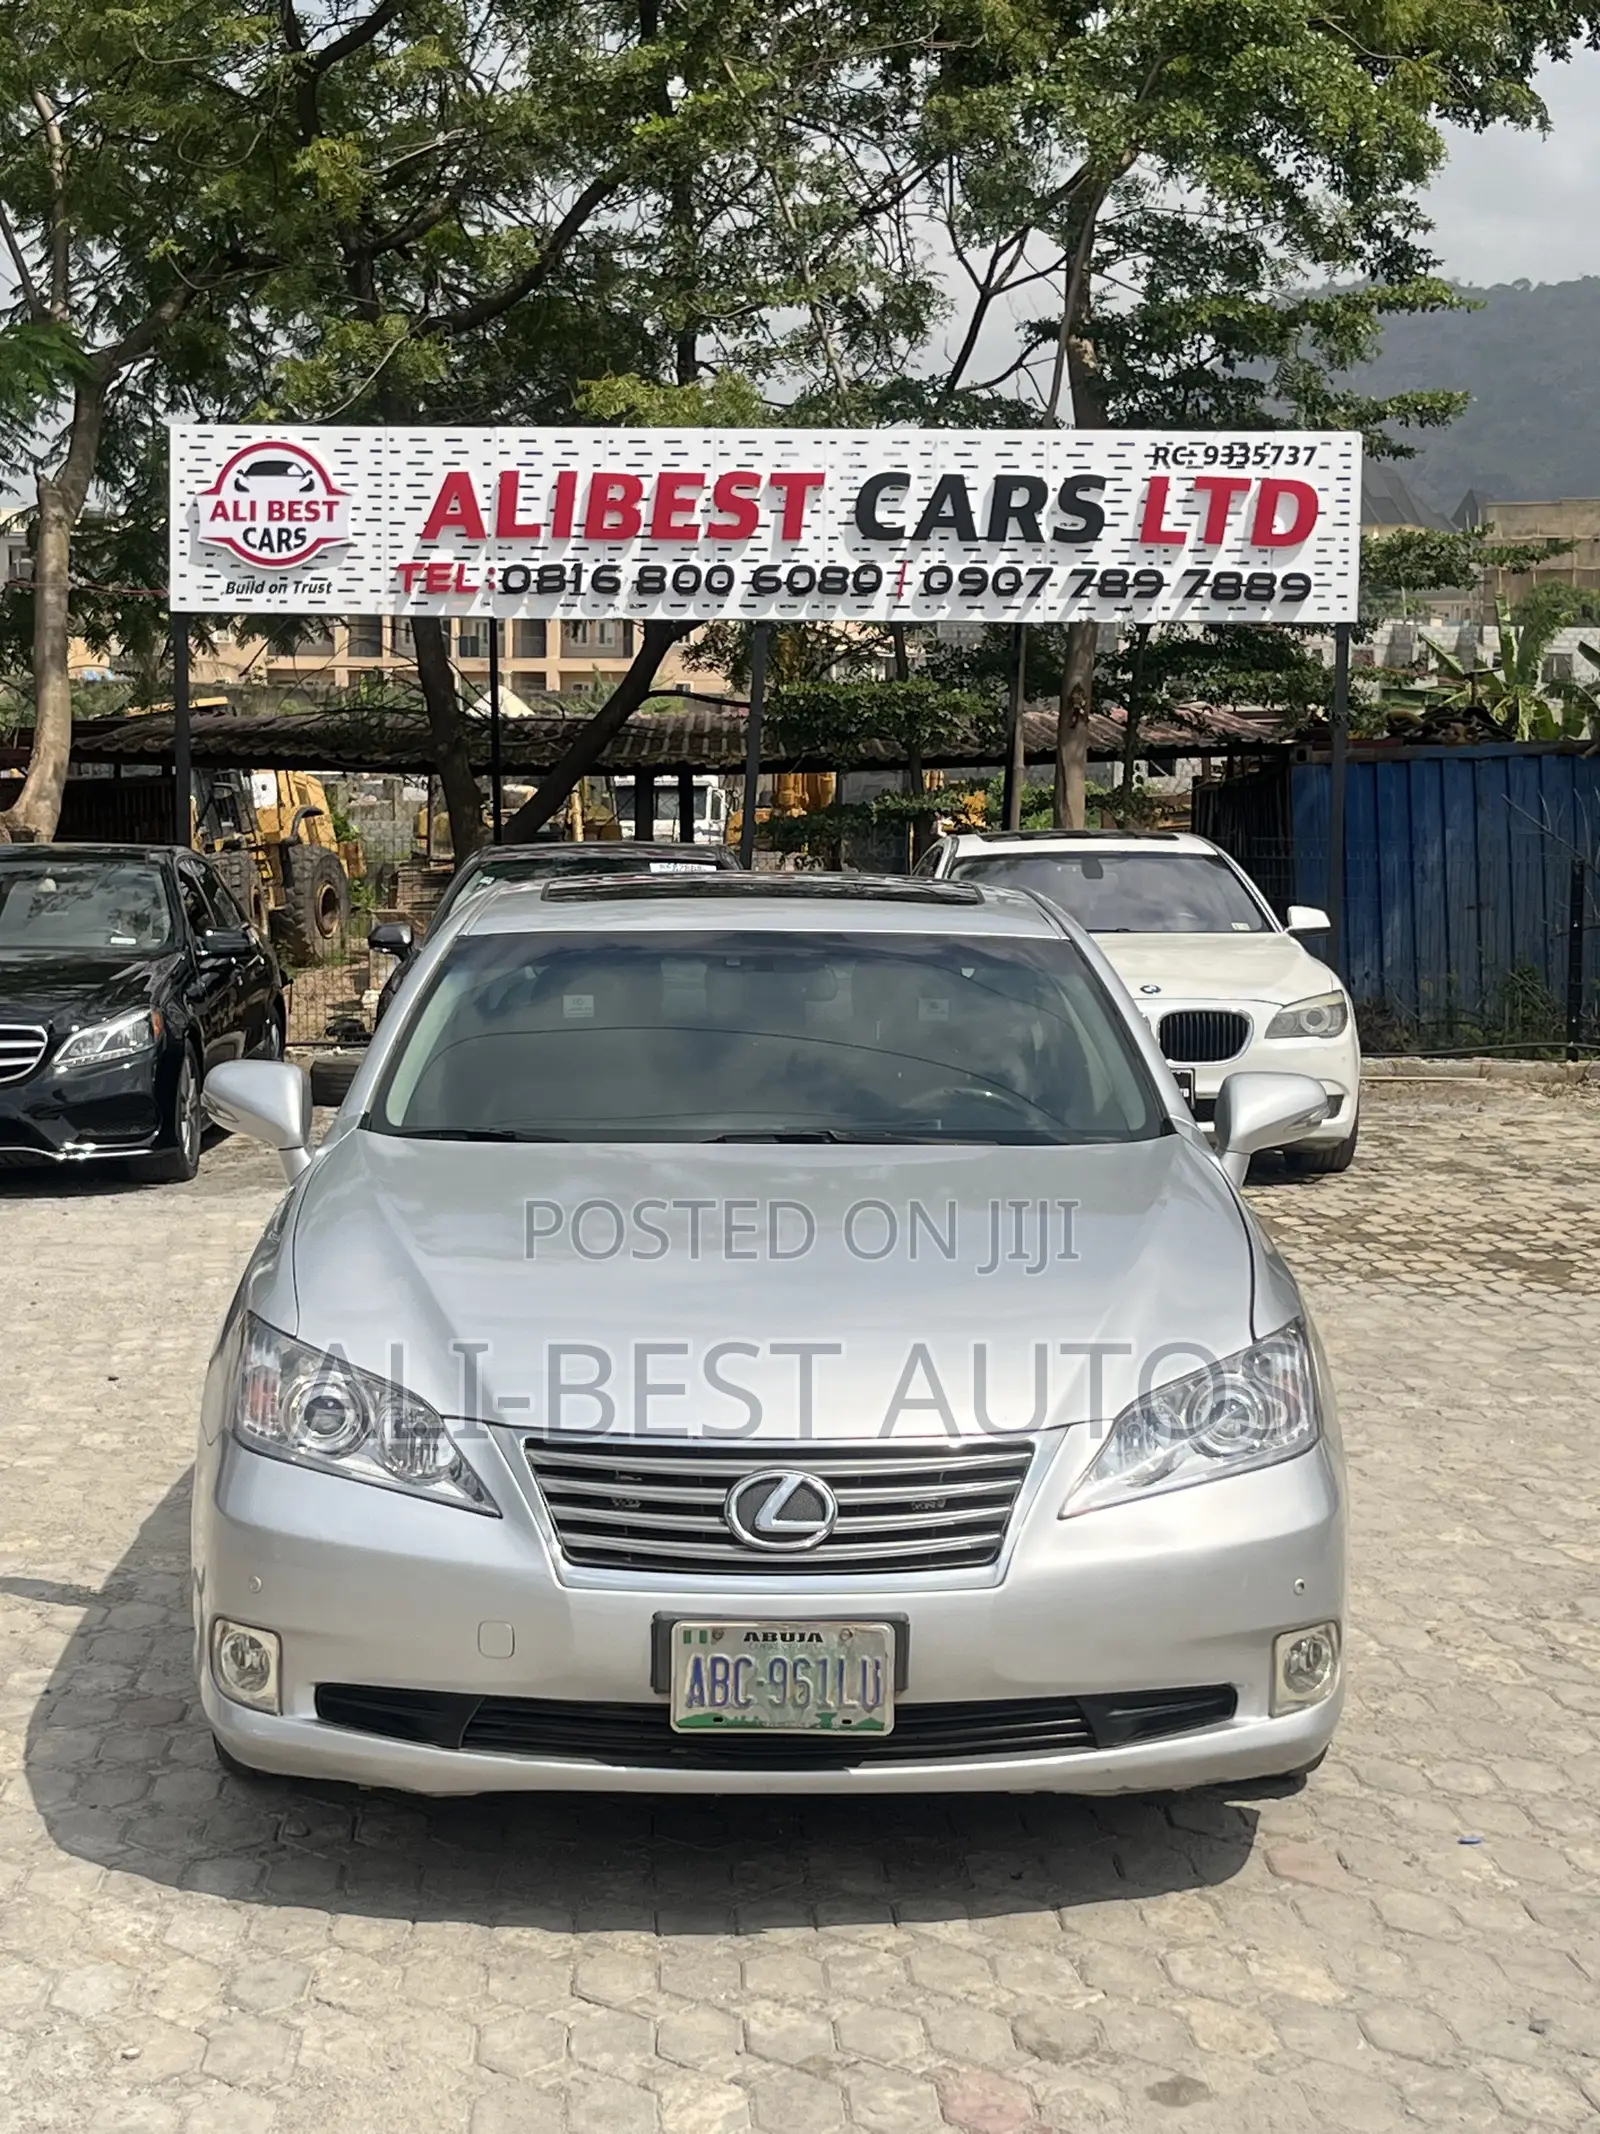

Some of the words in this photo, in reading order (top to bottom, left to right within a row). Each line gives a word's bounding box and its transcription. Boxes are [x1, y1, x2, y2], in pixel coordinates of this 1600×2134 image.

[1202, 444, 1317, 468] 9335737
[209, 500, 257, 522] ALI
[267, 500, 340, 523] BEST
[419, 470, 826, 542] ALIBEST
[854, 471, 1107, 544] CARS
[1139, 475, 1320, 547] LTD
[242, 527, 307, 553] CARS
[226, 581, 266, 596] Build
[269, 585, 288, 595] on
[294, 581, 333, 595] Trust
[636, 564, 735, 597] 800
[751, 564, 883, 596] 6080
[922, 565, 1053, 599] 0907
[1068, 567, 1164, 599] 789
[1181, 569, 1312, 602] 7889
[743, 1631, 823, 1643] ABUJA
